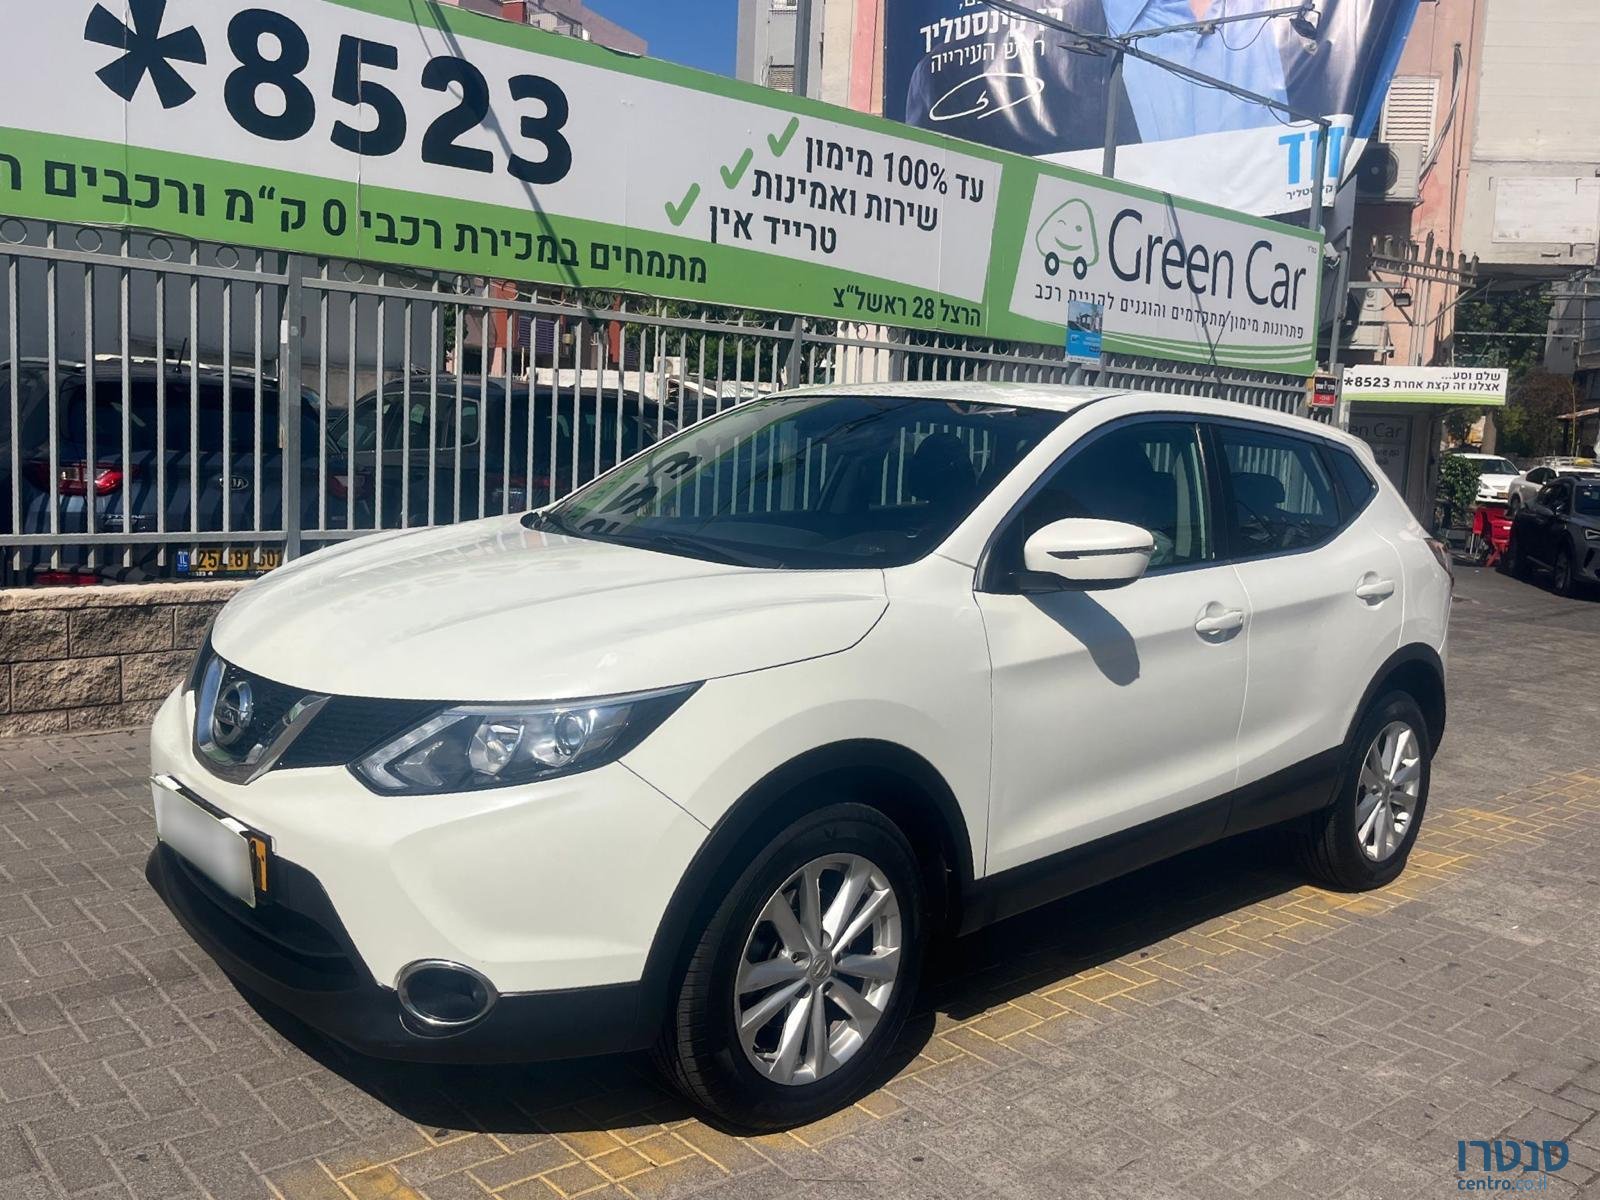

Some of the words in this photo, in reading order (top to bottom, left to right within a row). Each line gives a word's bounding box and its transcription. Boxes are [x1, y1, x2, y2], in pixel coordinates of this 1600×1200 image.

[930, 42, 995, 73] העירייה
[805, 137, 873, 177] מימון
[883, 152, 948, 195] 100%
[44, 160, 205, 216] ורכבים
[752, 170, 856, 216] ואמינות
[956, 173, 984, 202] עד
[323, 198, 346, 236] 0
[360, 210, 442, 249] רכבי
[709, 205, 754, 243] אין
[864, 193, 938, 232] שירות
[454, 223, 579, 267] במכירת
[764, 215, 837, 254] טרייד
[590, 242, 707, 284] מתמחים
[1108, 208, 1235, 300] Green
[1246, 240, 1307, 311] Car
[911, 296, 935, 321] 28
[1034, 283, 1062, 302] רכב
[1120, 297, 1166, 318] והוגנים
[940, 299, 981, 328] הרצל
[1262, 321, 1304, 339] פתרונות
[1393, 380, 1423, 389] אחרת
[1426, 381, 1450, 391] קצת
[1453, 381, 1466, 390] זה
[1468, 381, 1500, 391] אצלנו
[1475, 371, 1501, 381] שלם
